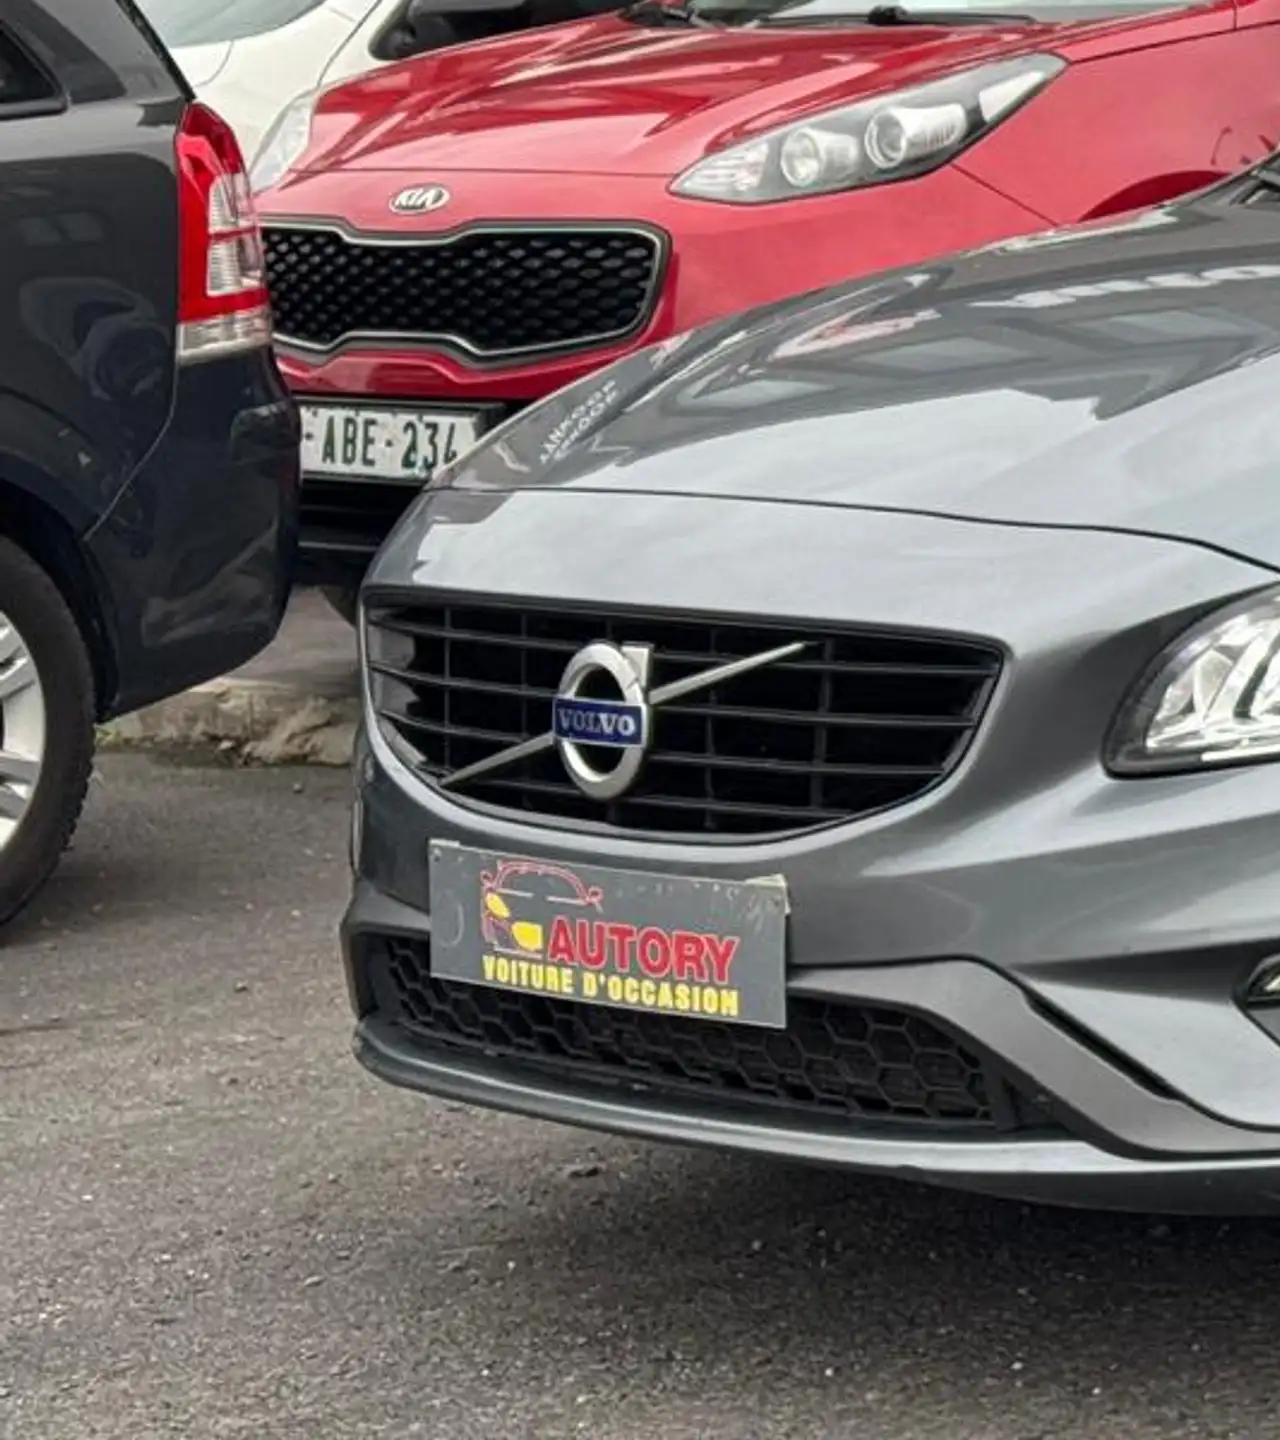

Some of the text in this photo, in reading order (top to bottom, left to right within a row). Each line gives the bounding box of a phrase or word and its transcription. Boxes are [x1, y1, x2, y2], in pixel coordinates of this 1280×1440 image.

[392, 187, 446, 211] KIA
[558, 707, 636, 736] VOLVO
[549, 915, 740, 985] AUTORY
[483, 955, 739, 1016] VOITURE D'OCCASION
